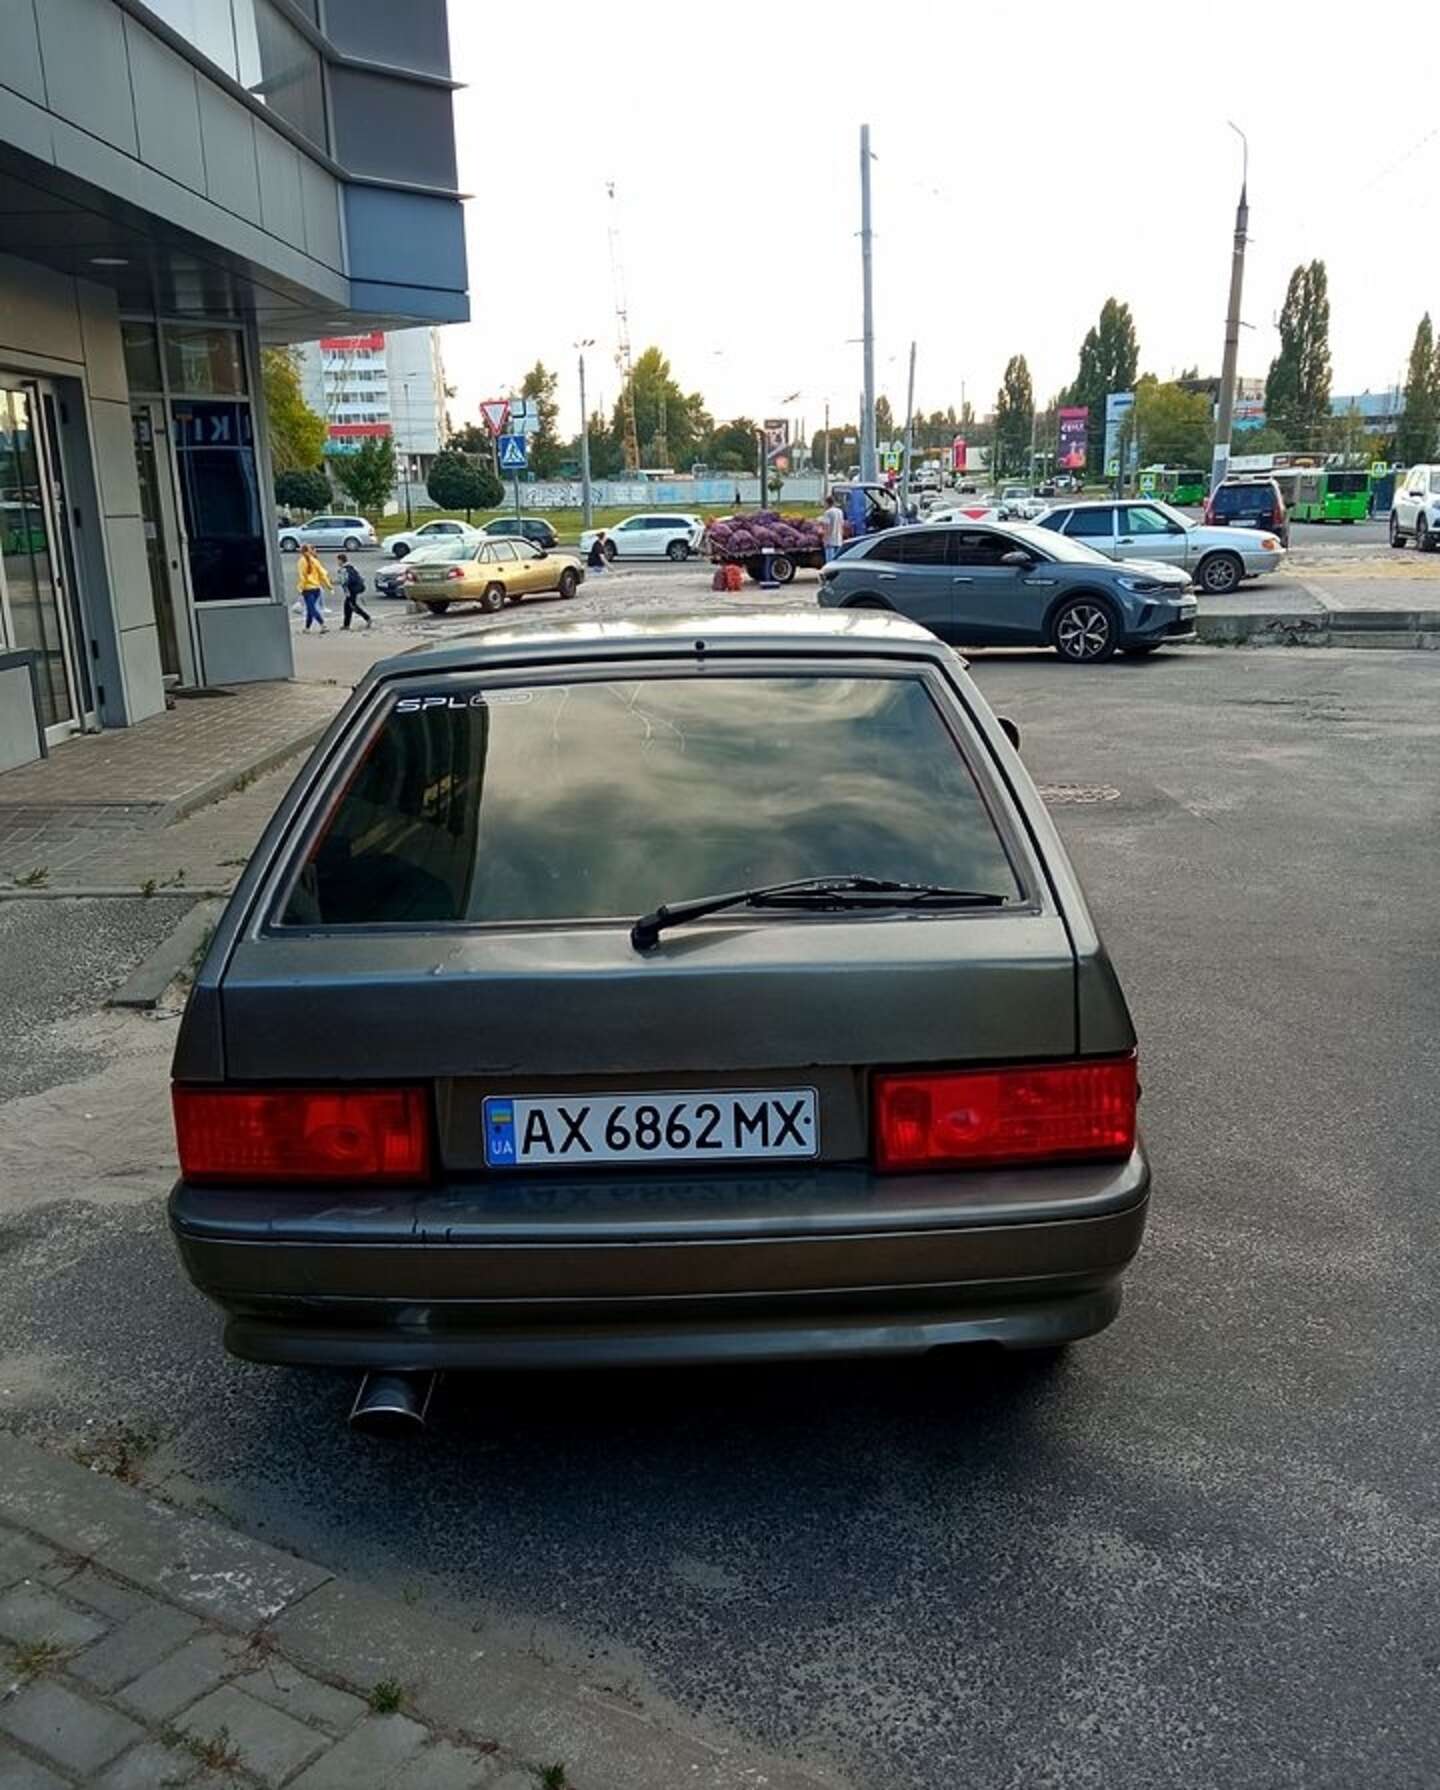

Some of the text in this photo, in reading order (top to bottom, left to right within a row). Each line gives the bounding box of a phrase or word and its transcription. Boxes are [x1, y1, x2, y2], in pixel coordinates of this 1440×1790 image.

[522, 1100, 807, 1155] AX 6862 MX
[491, 1140, 513, 1154] UA
